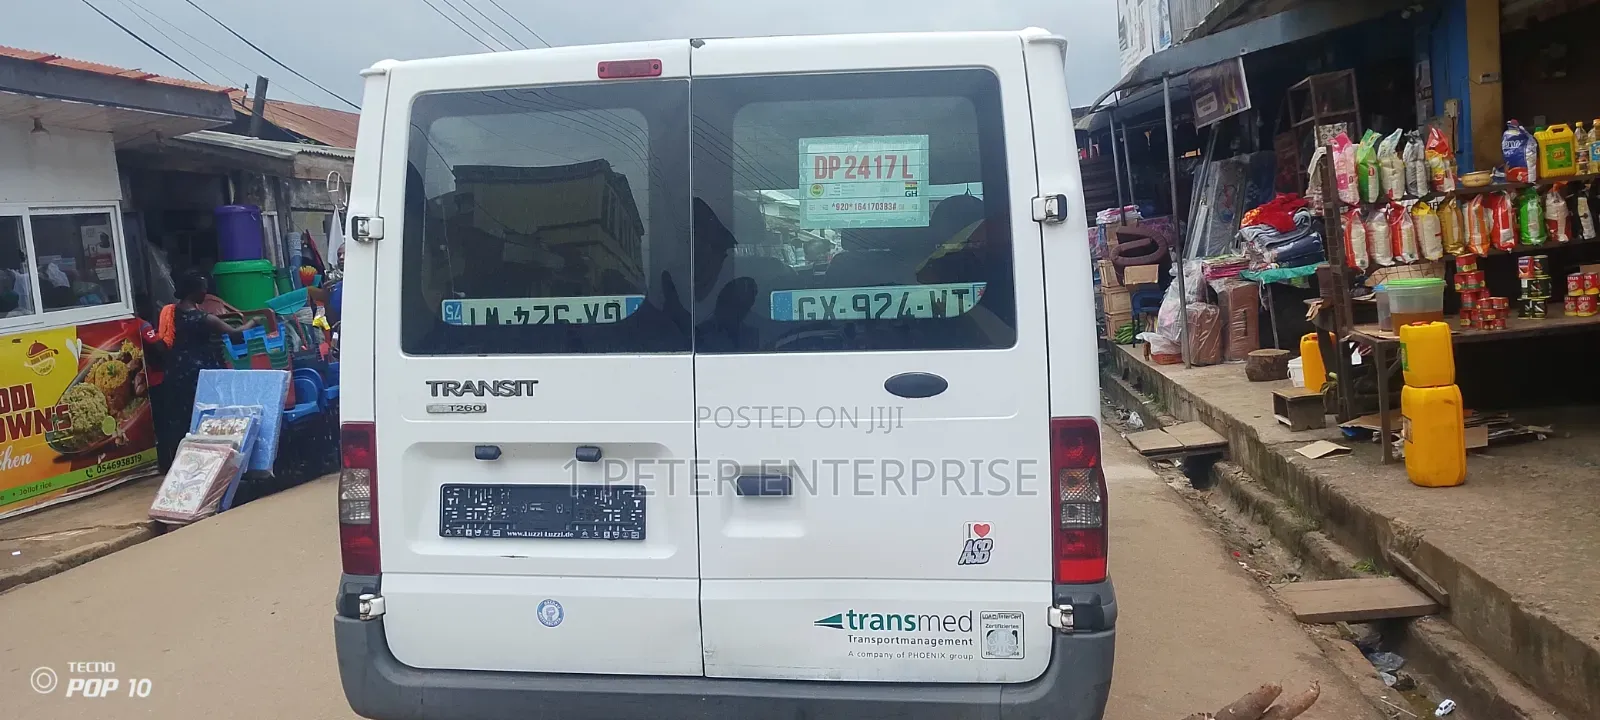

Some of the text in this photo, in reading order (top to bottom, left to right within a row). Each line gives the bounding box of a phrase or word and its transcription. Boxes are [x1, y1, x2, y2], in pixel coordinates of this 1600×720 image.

[814, 154, 914, 180] DP 2417 L
[904, 190, 918, 198] GH
[798, 288, 970, 320] GX-924-WT
[445, 305, 461, 321] 75
[425, 379, 539, 397] TRANSIT
[447, 404, 482, 412] T260
[96, 454, 143, 475] 0546938319
[845, 608, 973, 633] transmed
[847, 634, 974, 648] Transportmanagement
[856, 652, 894, 661] company
[896, 651, 905, 659] of
[907, 652, 946, 660] PHOENIX
[949, 652, 974, 662] group
